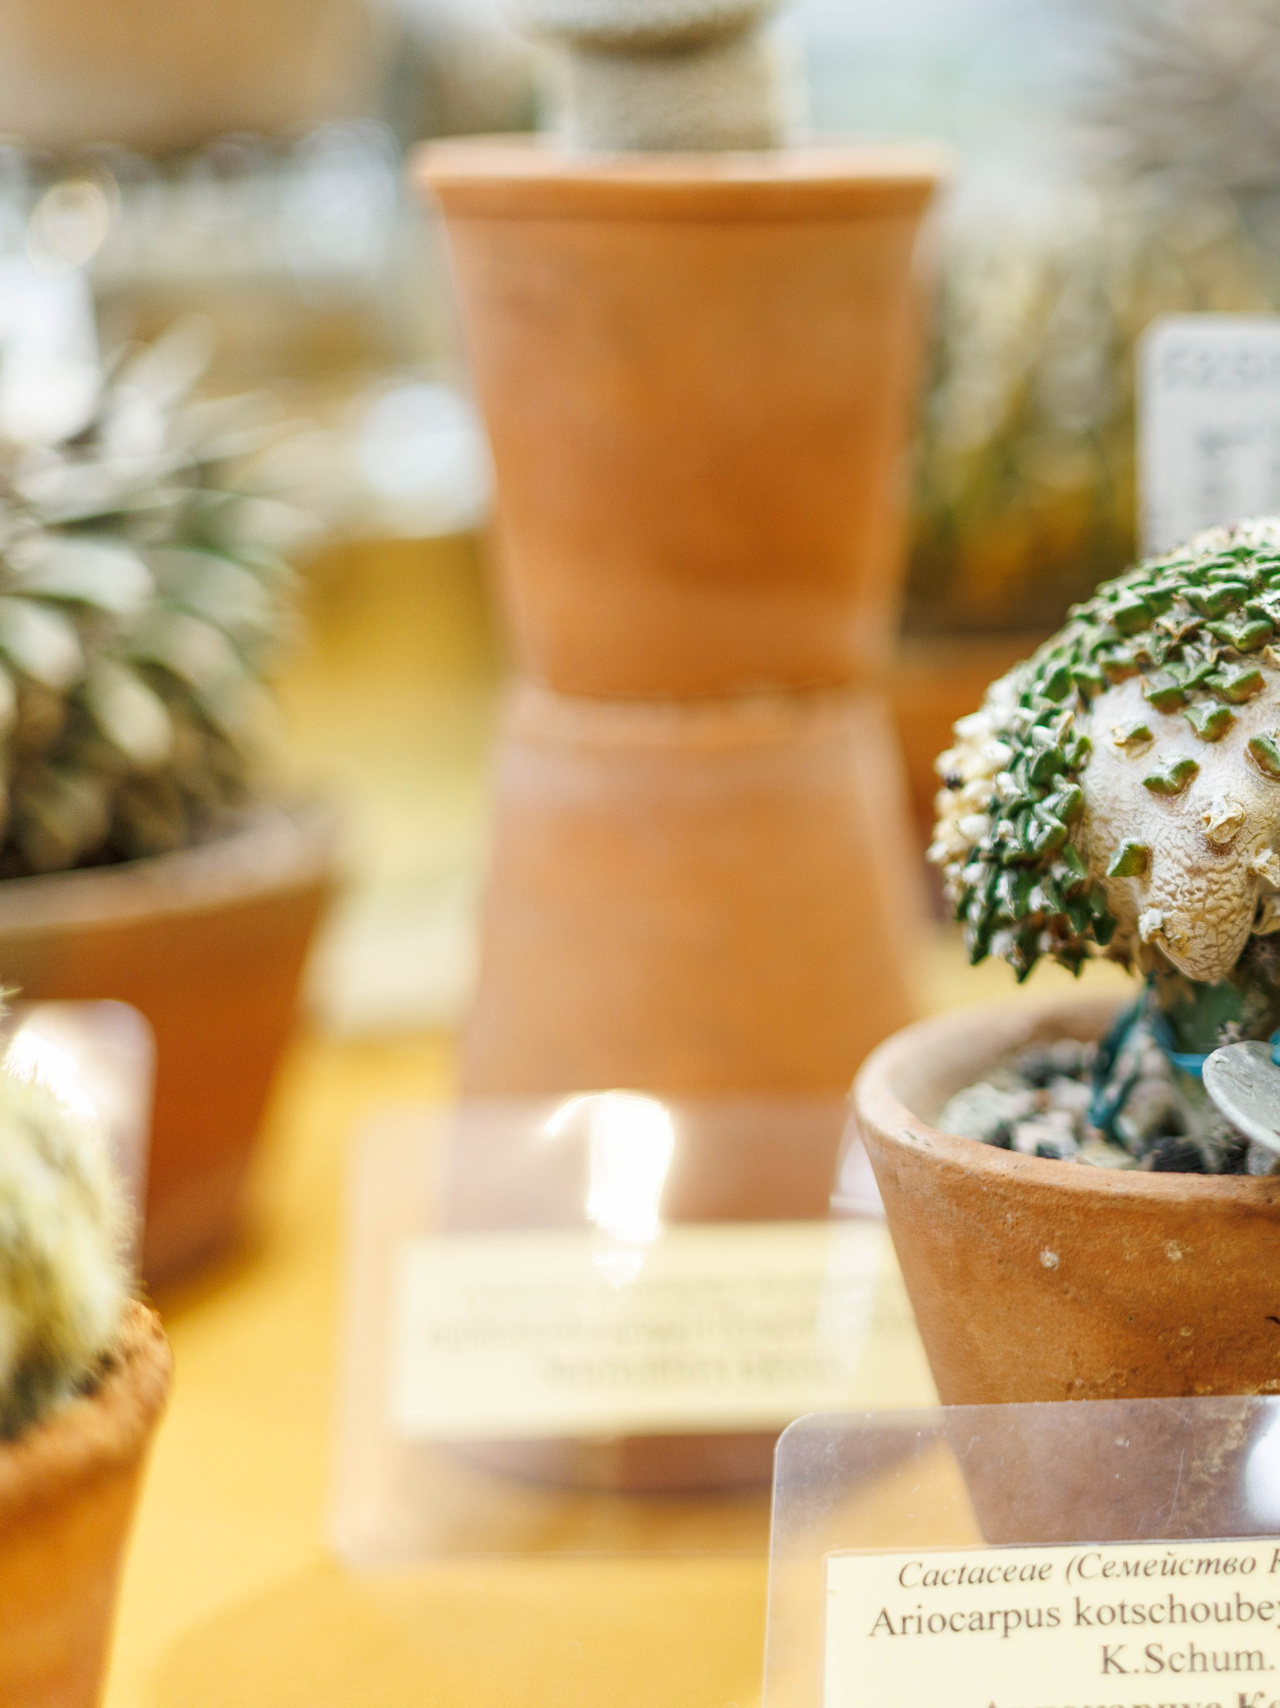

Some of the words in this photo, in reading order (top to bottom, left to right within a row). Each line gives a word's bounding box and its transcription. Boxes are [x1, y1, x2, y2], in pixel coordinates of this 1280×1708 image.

[898, 1560, 1053, 1588] Cactaceae
[1065, 1551, 1257, 1587] (Семейство
[868, 1604, 1061, 1639] Ariocarpus
[1099, 1641, 1276, 1675] K.Schum.
